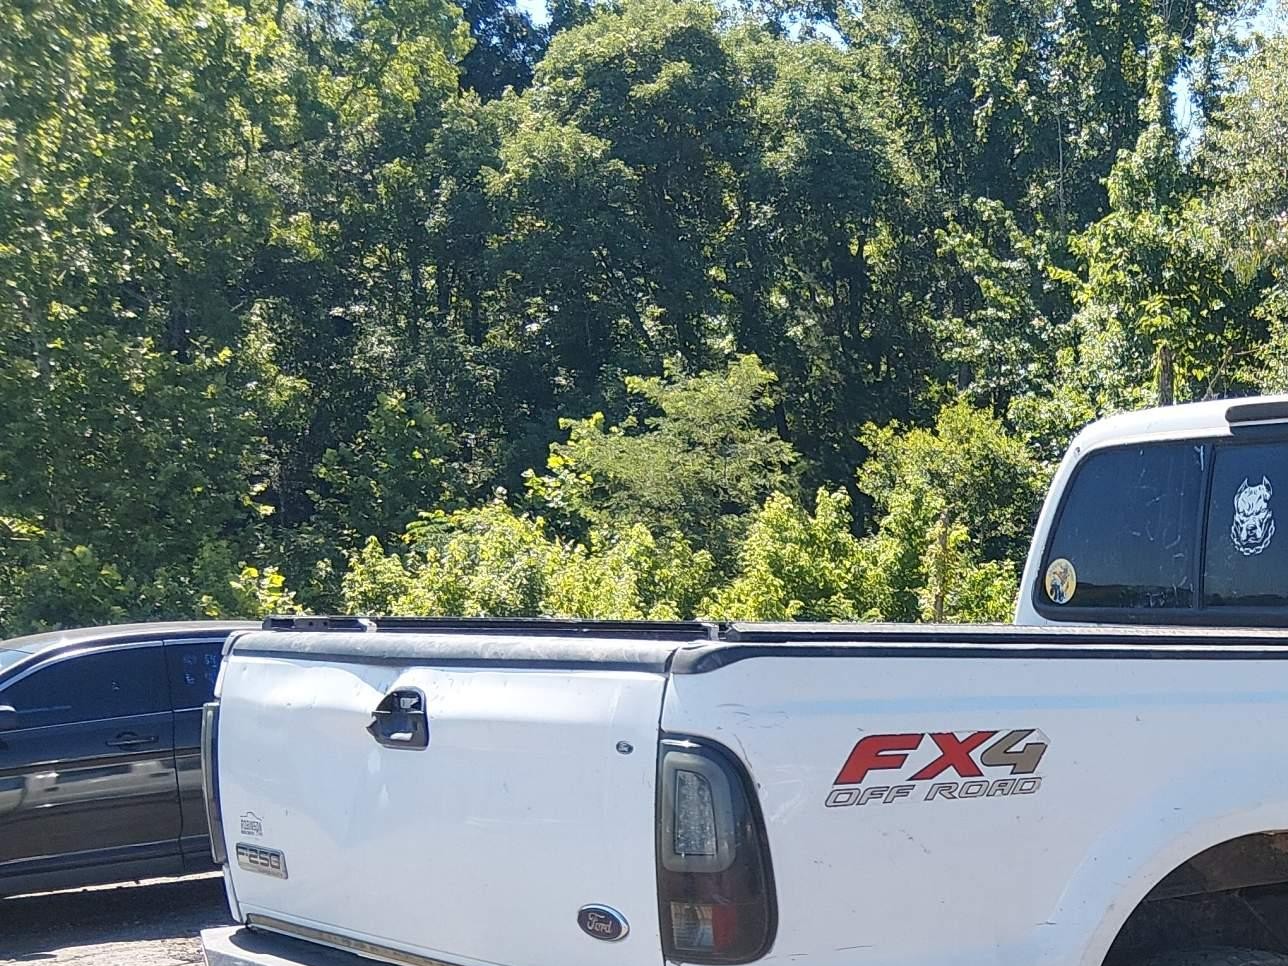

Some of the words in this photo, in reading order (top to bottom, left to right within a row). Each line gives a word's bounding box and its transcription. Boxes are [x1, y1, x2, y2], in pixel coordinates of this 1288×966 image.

[833, 729, 1048, 785] FX4
[825, 784, 916, 807] OFF
[924, 777, 1042, 801] ROAD
[586, 912, 613, 934] Ford
